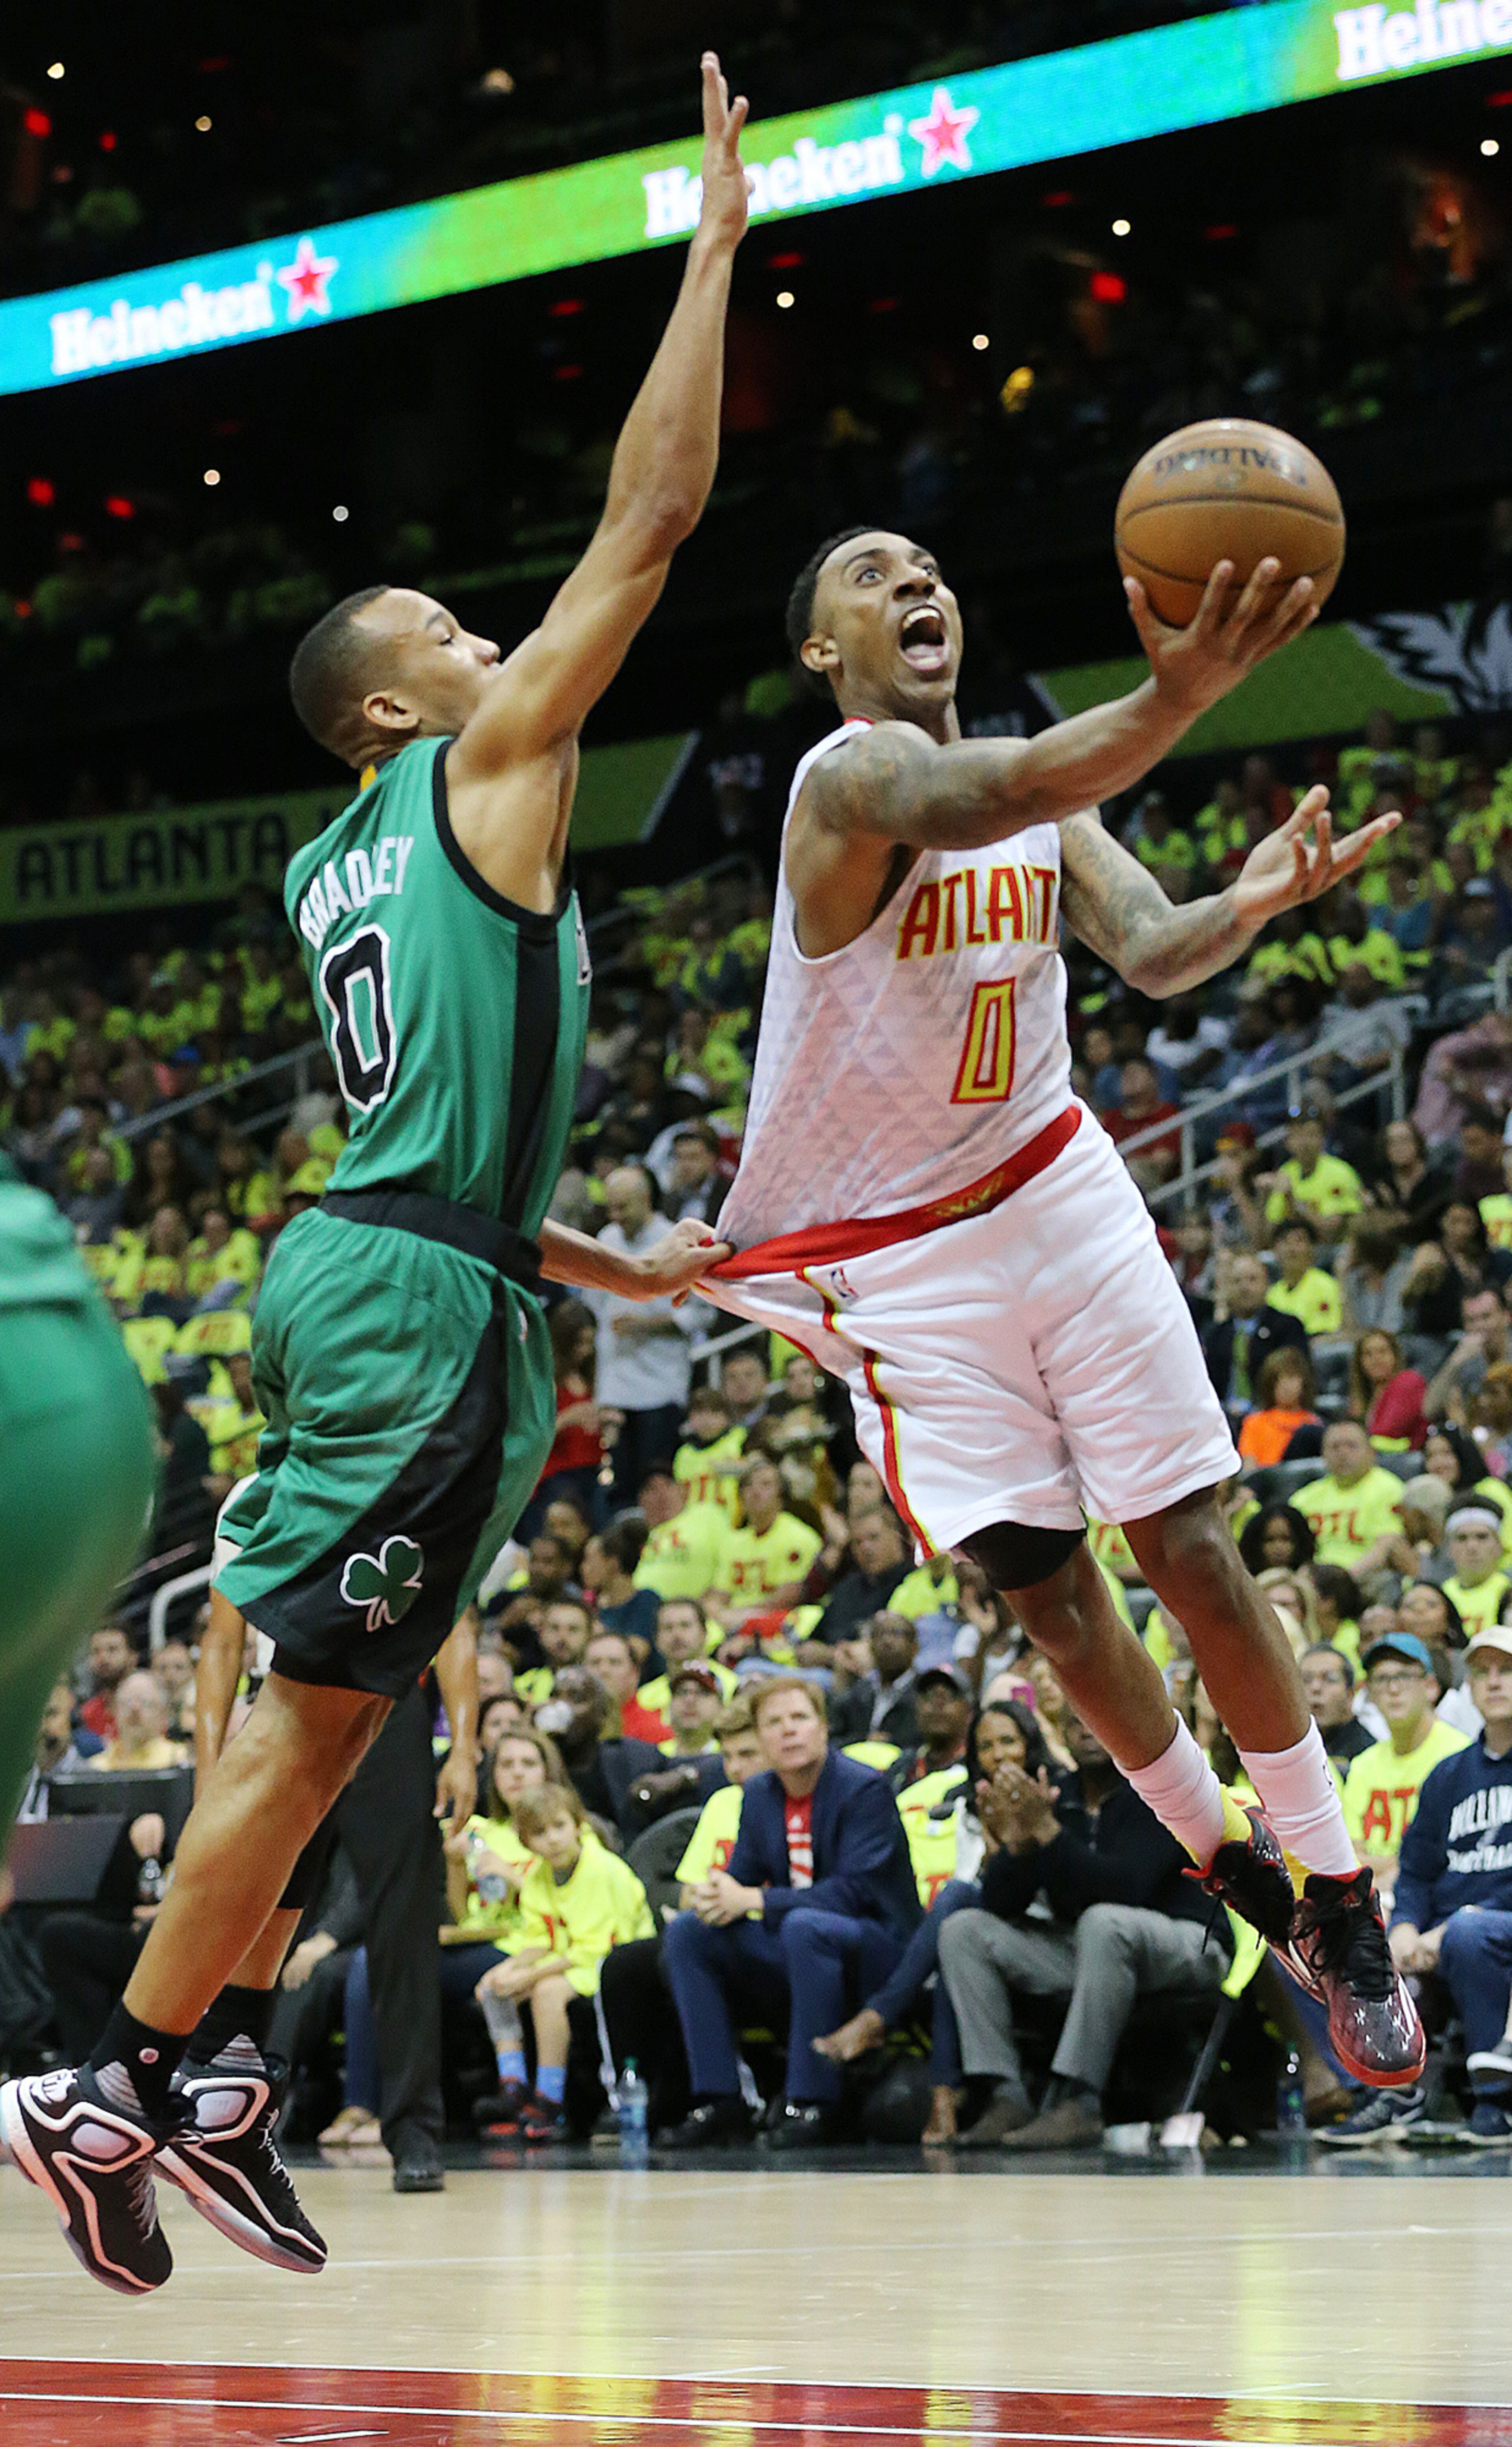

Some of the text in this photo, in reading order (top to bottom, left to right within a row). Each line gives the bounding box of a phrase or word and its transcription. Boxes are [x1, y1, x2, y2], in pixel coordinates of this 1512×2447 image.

[642, 134, 905, 239] Heneken
[50, 280, 276, 376] Heineken
[1154, 447, 1308, 486] ALDING
[17, 812, 289, 899] ATLANTA
[300, 836, 414, 951] BRADEY
[319, 922, 397, 1114] 0
[949, 977, 1016, 1104] 0
